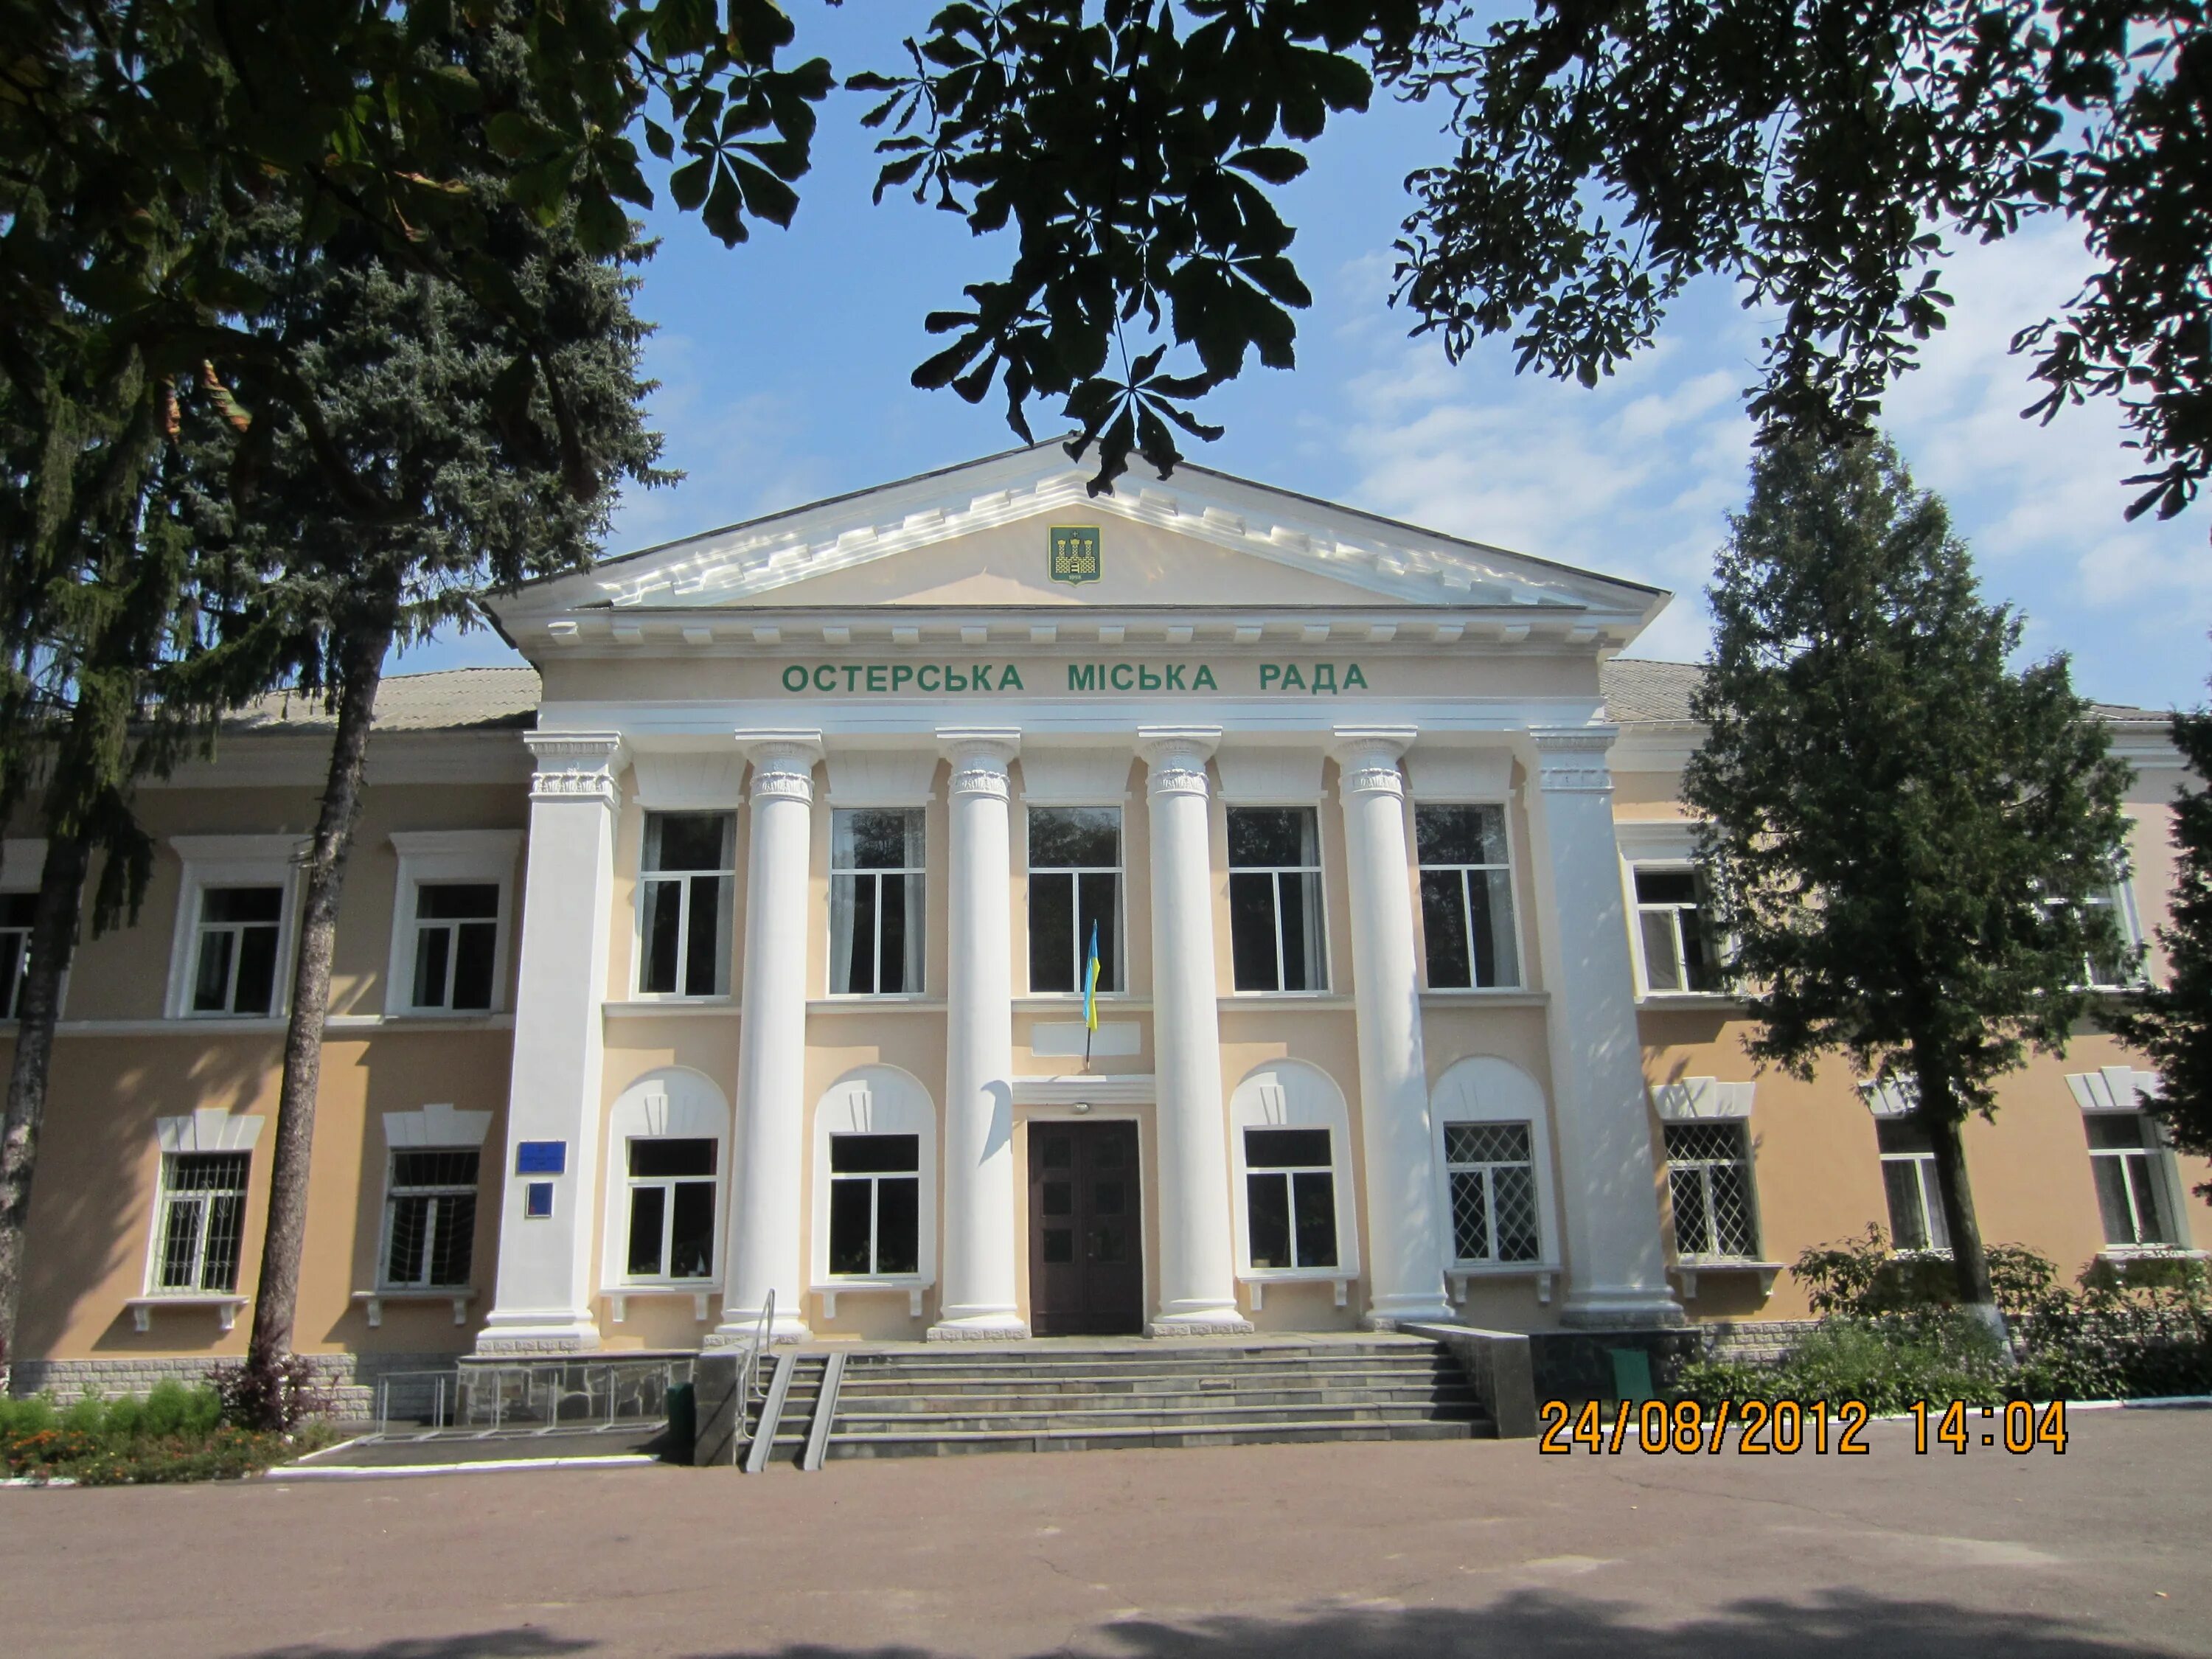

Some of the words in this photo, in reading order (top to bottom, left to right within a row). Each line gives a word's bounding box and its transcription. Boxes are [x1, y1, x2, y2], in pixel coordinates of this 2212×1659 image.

[782, 664, 1025, 692] ОСТЕРСЬКА
[1068, 664, 1218, 692] МІСЬКА
[1259, 664, 1368, 694] РАДА
